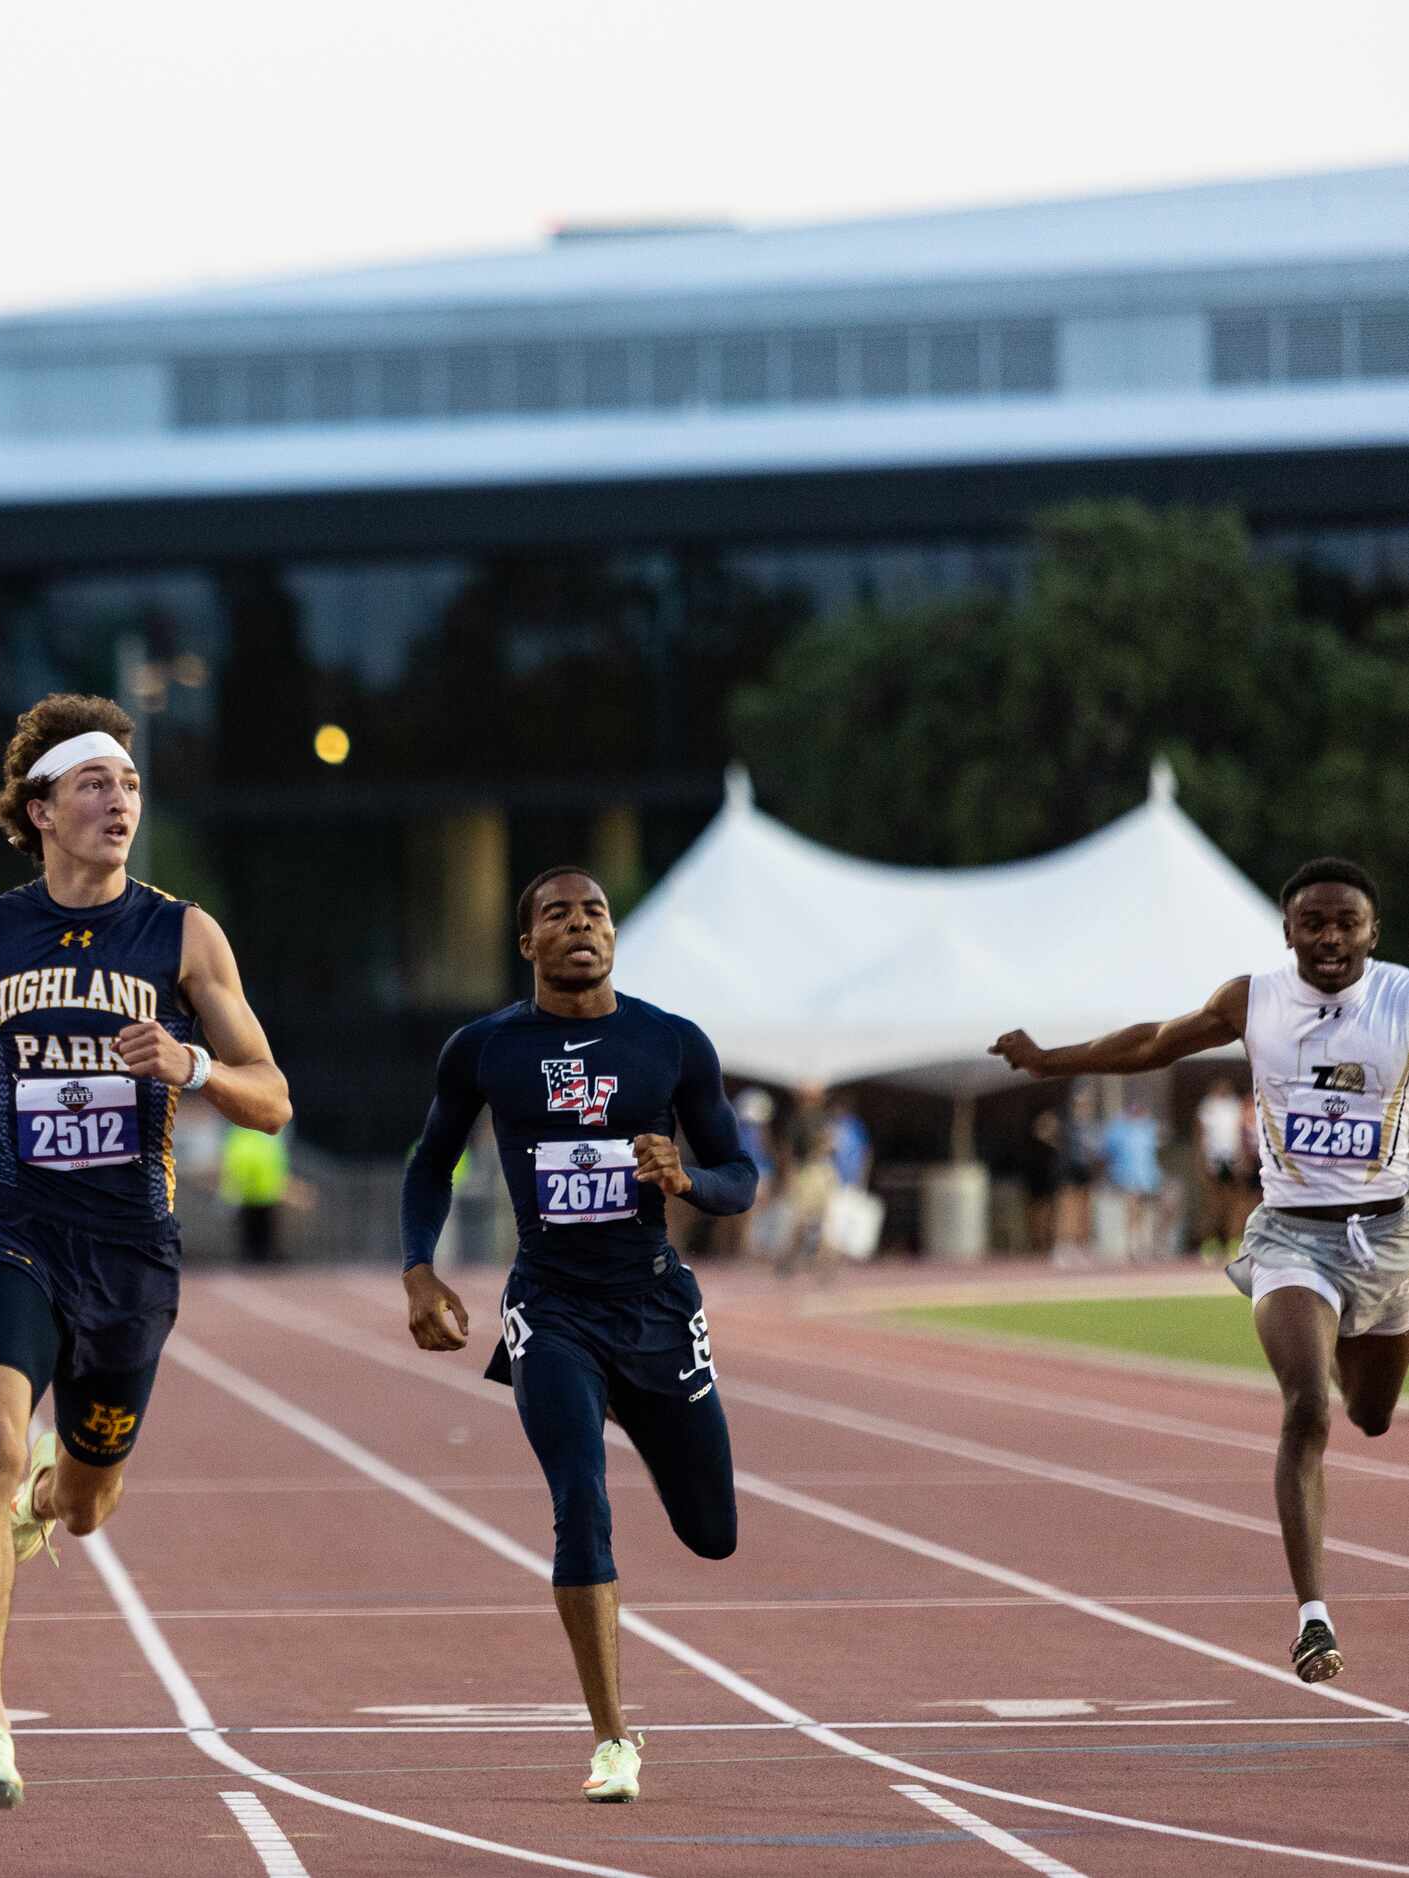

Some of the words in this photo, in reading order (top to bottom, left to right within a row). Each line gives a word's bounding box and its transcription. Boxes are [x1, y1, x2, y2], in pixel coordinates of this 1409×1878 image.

[14, 1034, 130, 1072] PARK
[57, 1092, 93, 1102] STATE
[541, 1059, 618, 1127] EV
[31, 1111, 125, 1157] 2512
[1290, 1116, 1374, 1157] 2239
[546, 1171, 628, 1212] 2674
